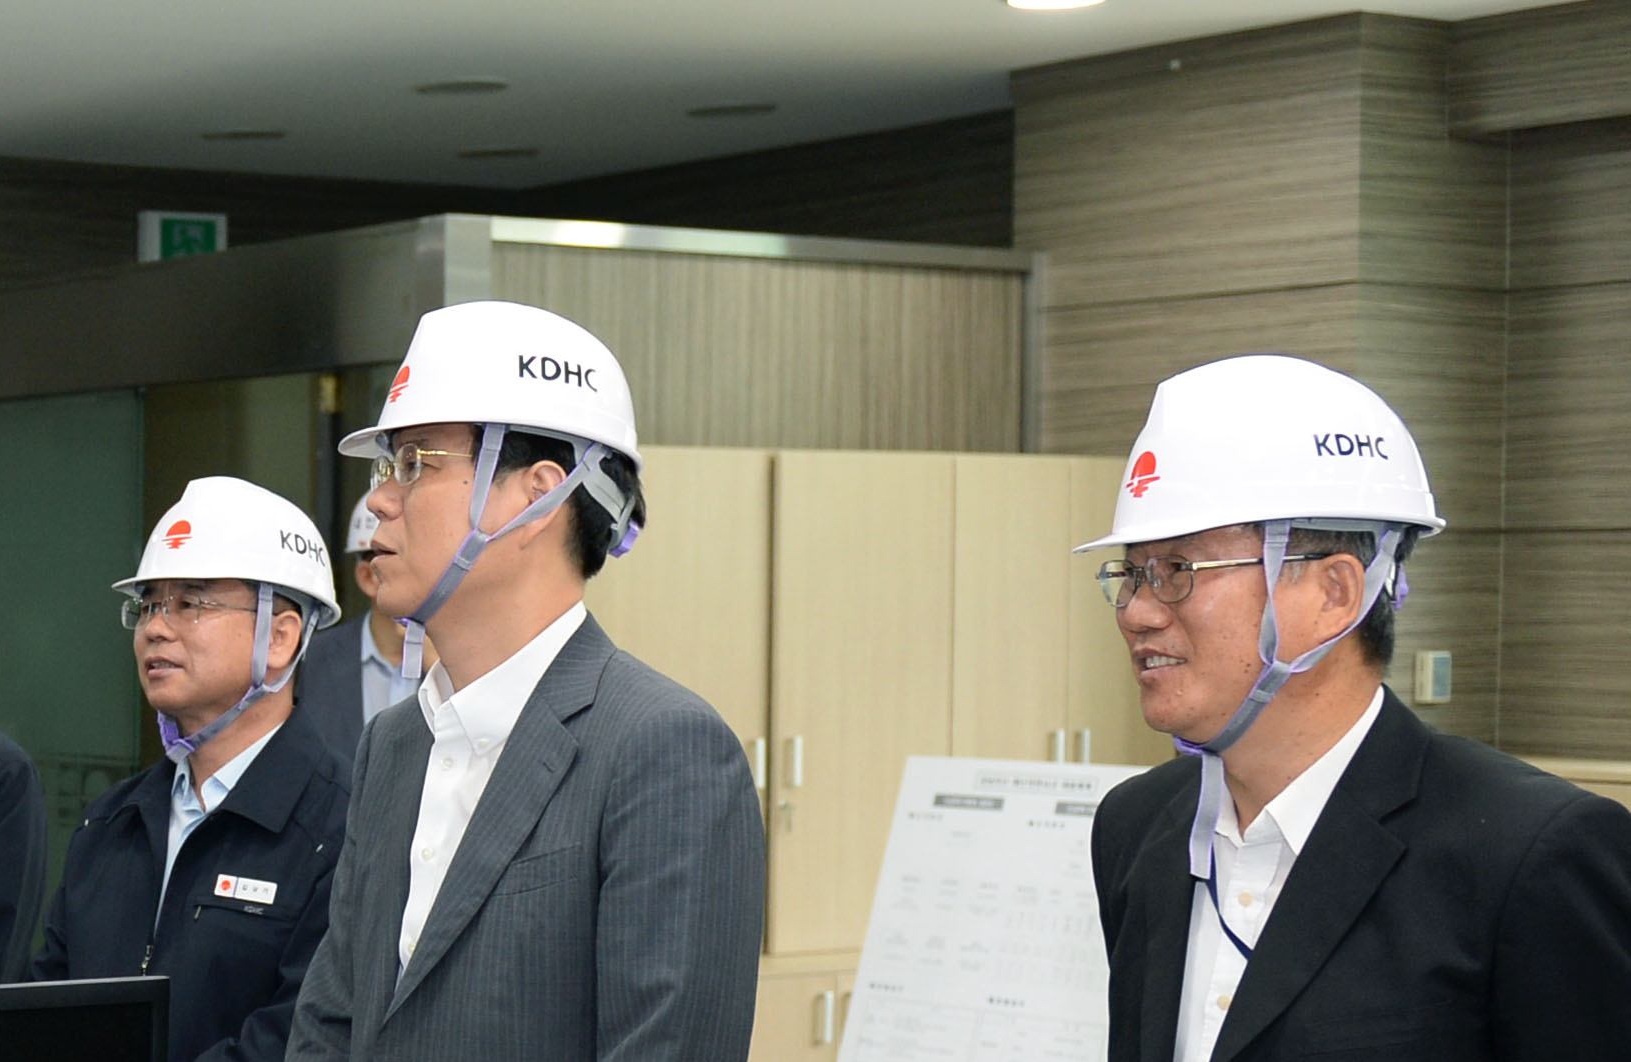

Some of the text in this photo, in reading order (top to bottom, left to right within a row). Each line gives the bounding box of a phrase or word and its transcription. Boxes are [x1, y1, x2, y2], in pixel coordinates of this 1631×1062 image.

[518, 354, 598, 393] KDHC
[1313, 432, 1389, 460] KDHC
[279, 528, 326, 568] KDHC
